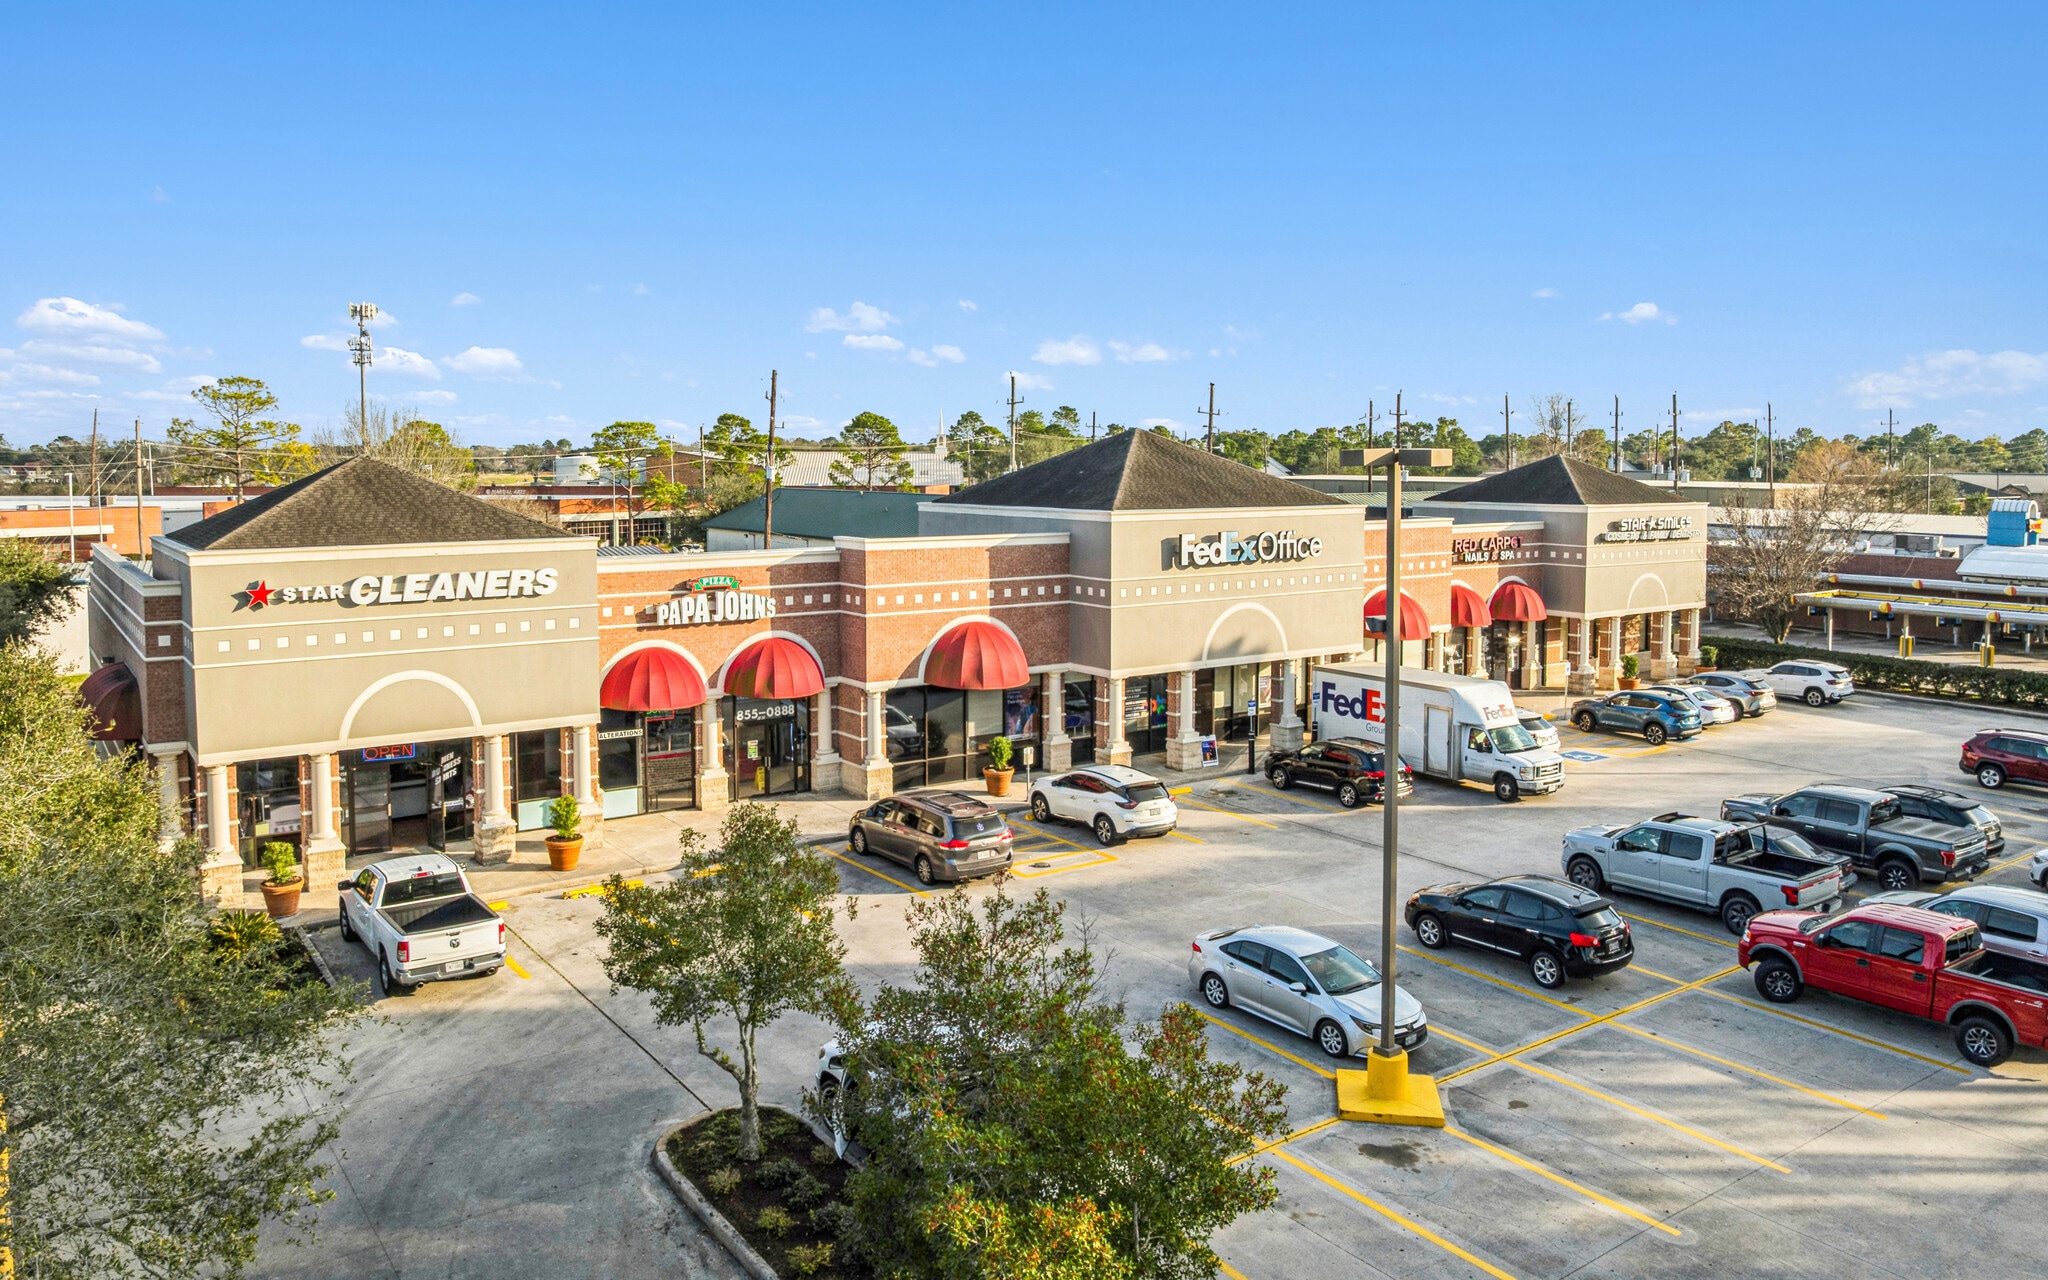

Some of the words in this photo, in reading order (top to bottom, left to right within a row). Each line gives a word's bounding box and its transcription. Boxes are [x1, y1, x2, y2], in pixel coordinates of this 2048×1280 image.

[1620, 518, 1646, 531] STAR
[1657, 516, 1692, 529] SMILES
[1180, 531, 1257, 566] FedEx
[1258, 530, 1323, 561] Office
[1454, 539, 1477, 553] RED
[1481, 535, 1524, 551] CARPET
[1465, 551, 1489, 562] NAILS
[1491, 551, 1498, 561] &
[1500, 550, 1515, 561] SPA
[282, 584, 345, 602] STAR
[350, 567, 559, 605] CLEANERS
[702, 576, 732, 586] PIZZA
[657, 592, 711, 626] PAPA
[736, 704, 795, 721] 855-0888
[1483, 703, 1515, 721] FedEx
[599, 730, 643, 740] ALTERATIONS
[1365, 722, 1386, 734] Grou
[364, 743, 414, 760] OPEN
[431, 756, 462, 779] BUINESS
